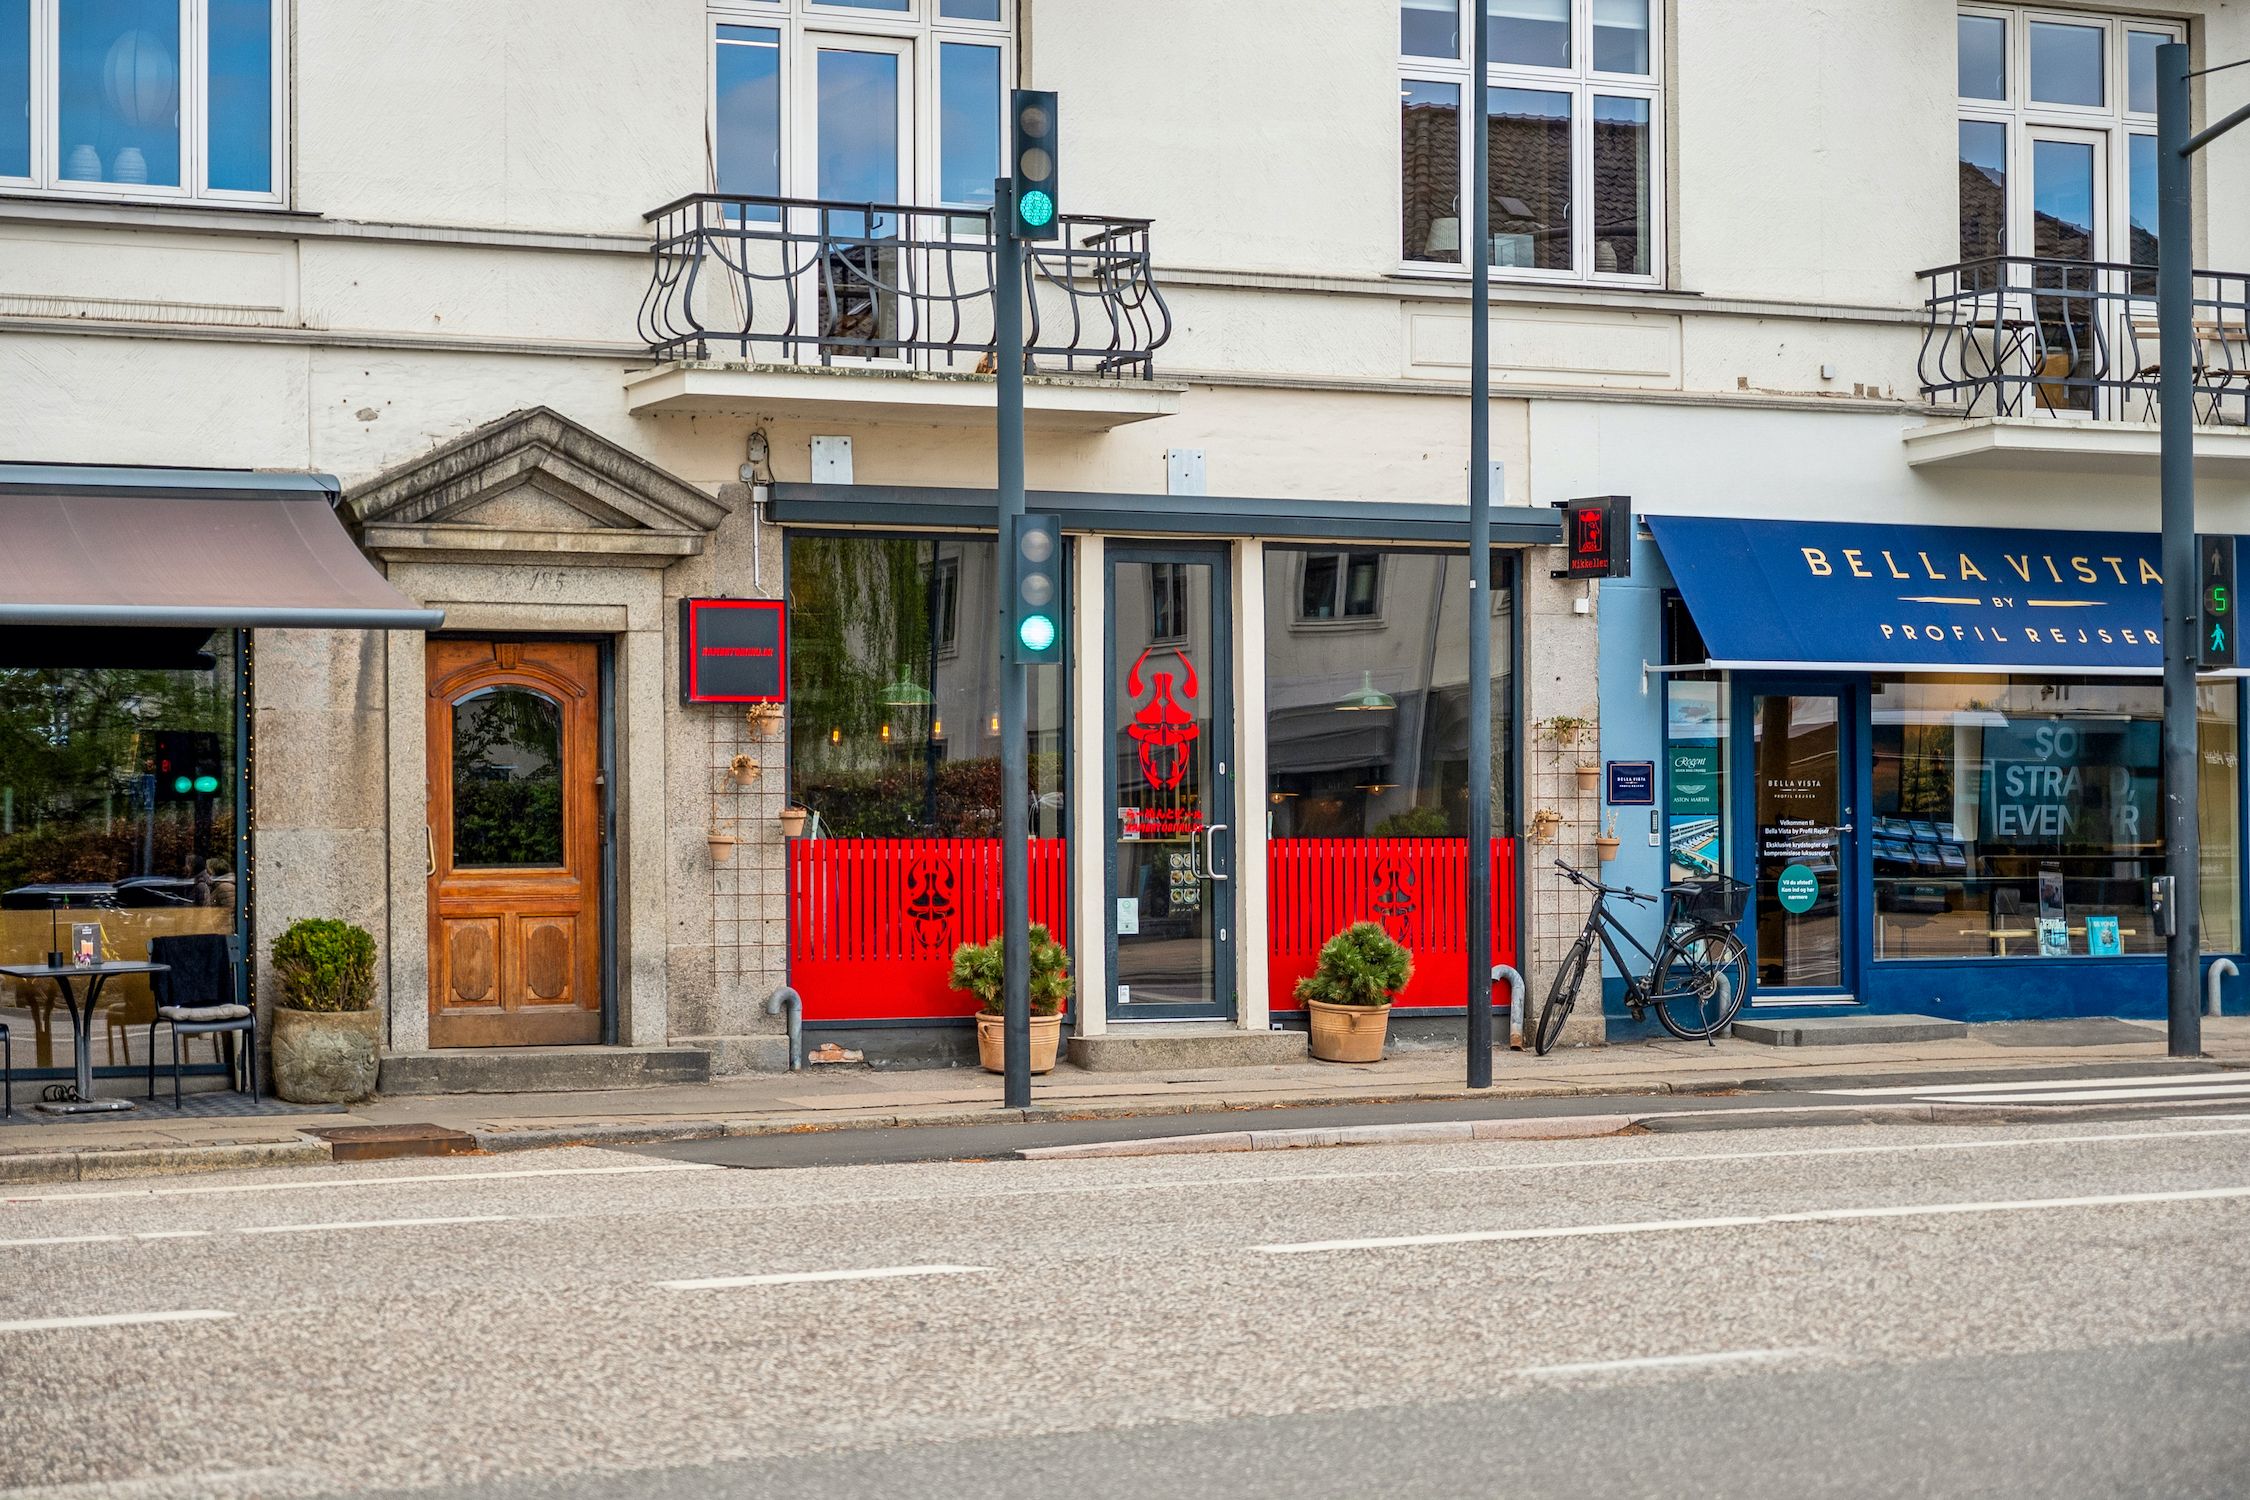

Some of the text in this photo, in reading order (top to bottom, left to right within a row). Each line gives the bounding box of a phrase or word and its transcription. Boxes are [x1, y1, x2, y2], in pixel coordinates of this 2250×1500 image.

[1571, 558, 1609, 569] Mikkeller
[1800, 547, 2163, 585] BELLA VISTA
[1991, 596, 2014, 608] BY
[2214, 587, 2227, 611] 5
[1880, 623, 2161, 645] PROFIL REJSER
[1674, 756, 1706, 769] Regent
[2005, 765, 2136, 802] STRAD,
[1765, 827, 1778, 835] Bella
[1778, 827, 1792, 835] Vista
[1799, 827, 1813, 835] Profil
[1999, 804, 2140, 836] EVENR
